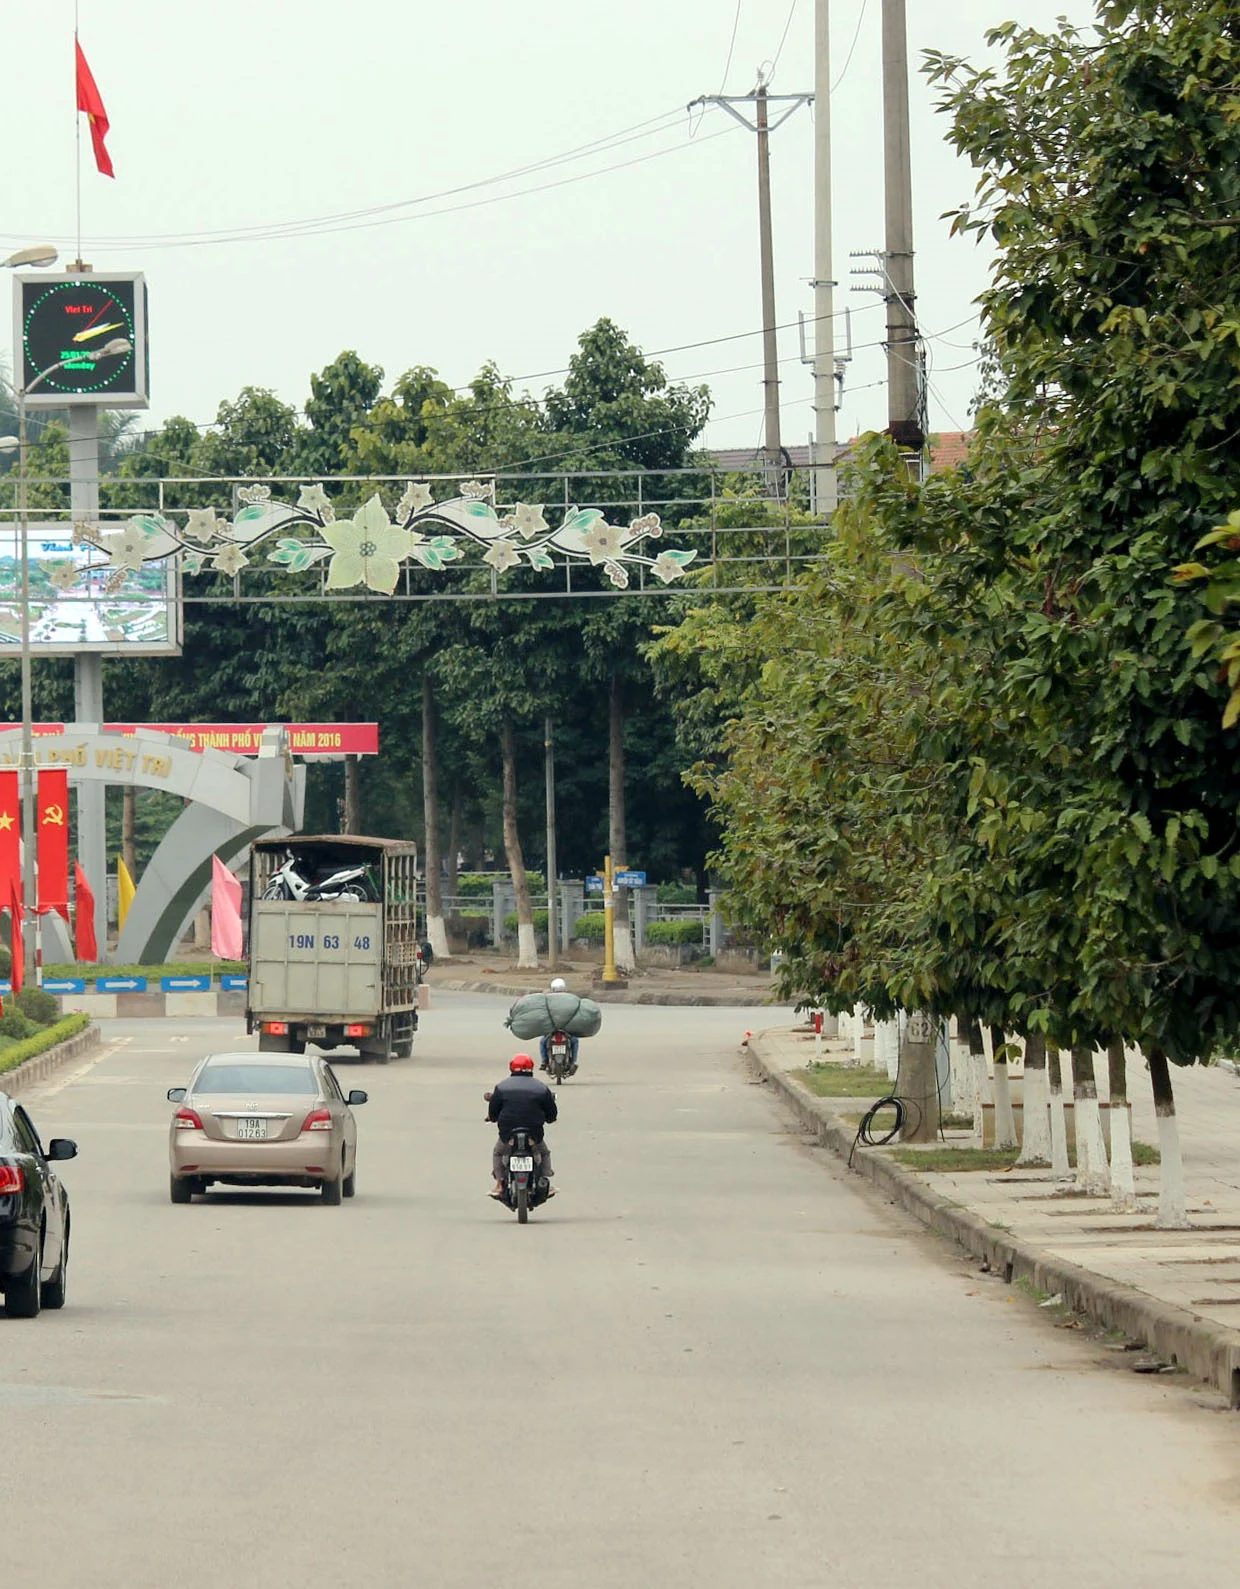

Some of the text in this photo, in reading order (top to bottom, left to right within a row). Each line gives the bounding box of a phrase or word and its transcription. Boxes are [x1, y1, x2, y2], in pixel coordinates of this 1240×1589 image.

[199, 730, 229, 747] THÀNH
[232, 728, 251, 747] PHỐ
[294, 730, 315, 747] NĂM
[317, 732, 342, 747] 2016
[48, 742, 88, 767] PHỐ
[95, 748, 136, 773] VIỆT
[142, 754, 173, 777] TRÌ
[289, 935, 370, 950] 19N 63 48
[245, 1120, 260, 1128] 19A
[239, 1129, 266, 1138] 01263
